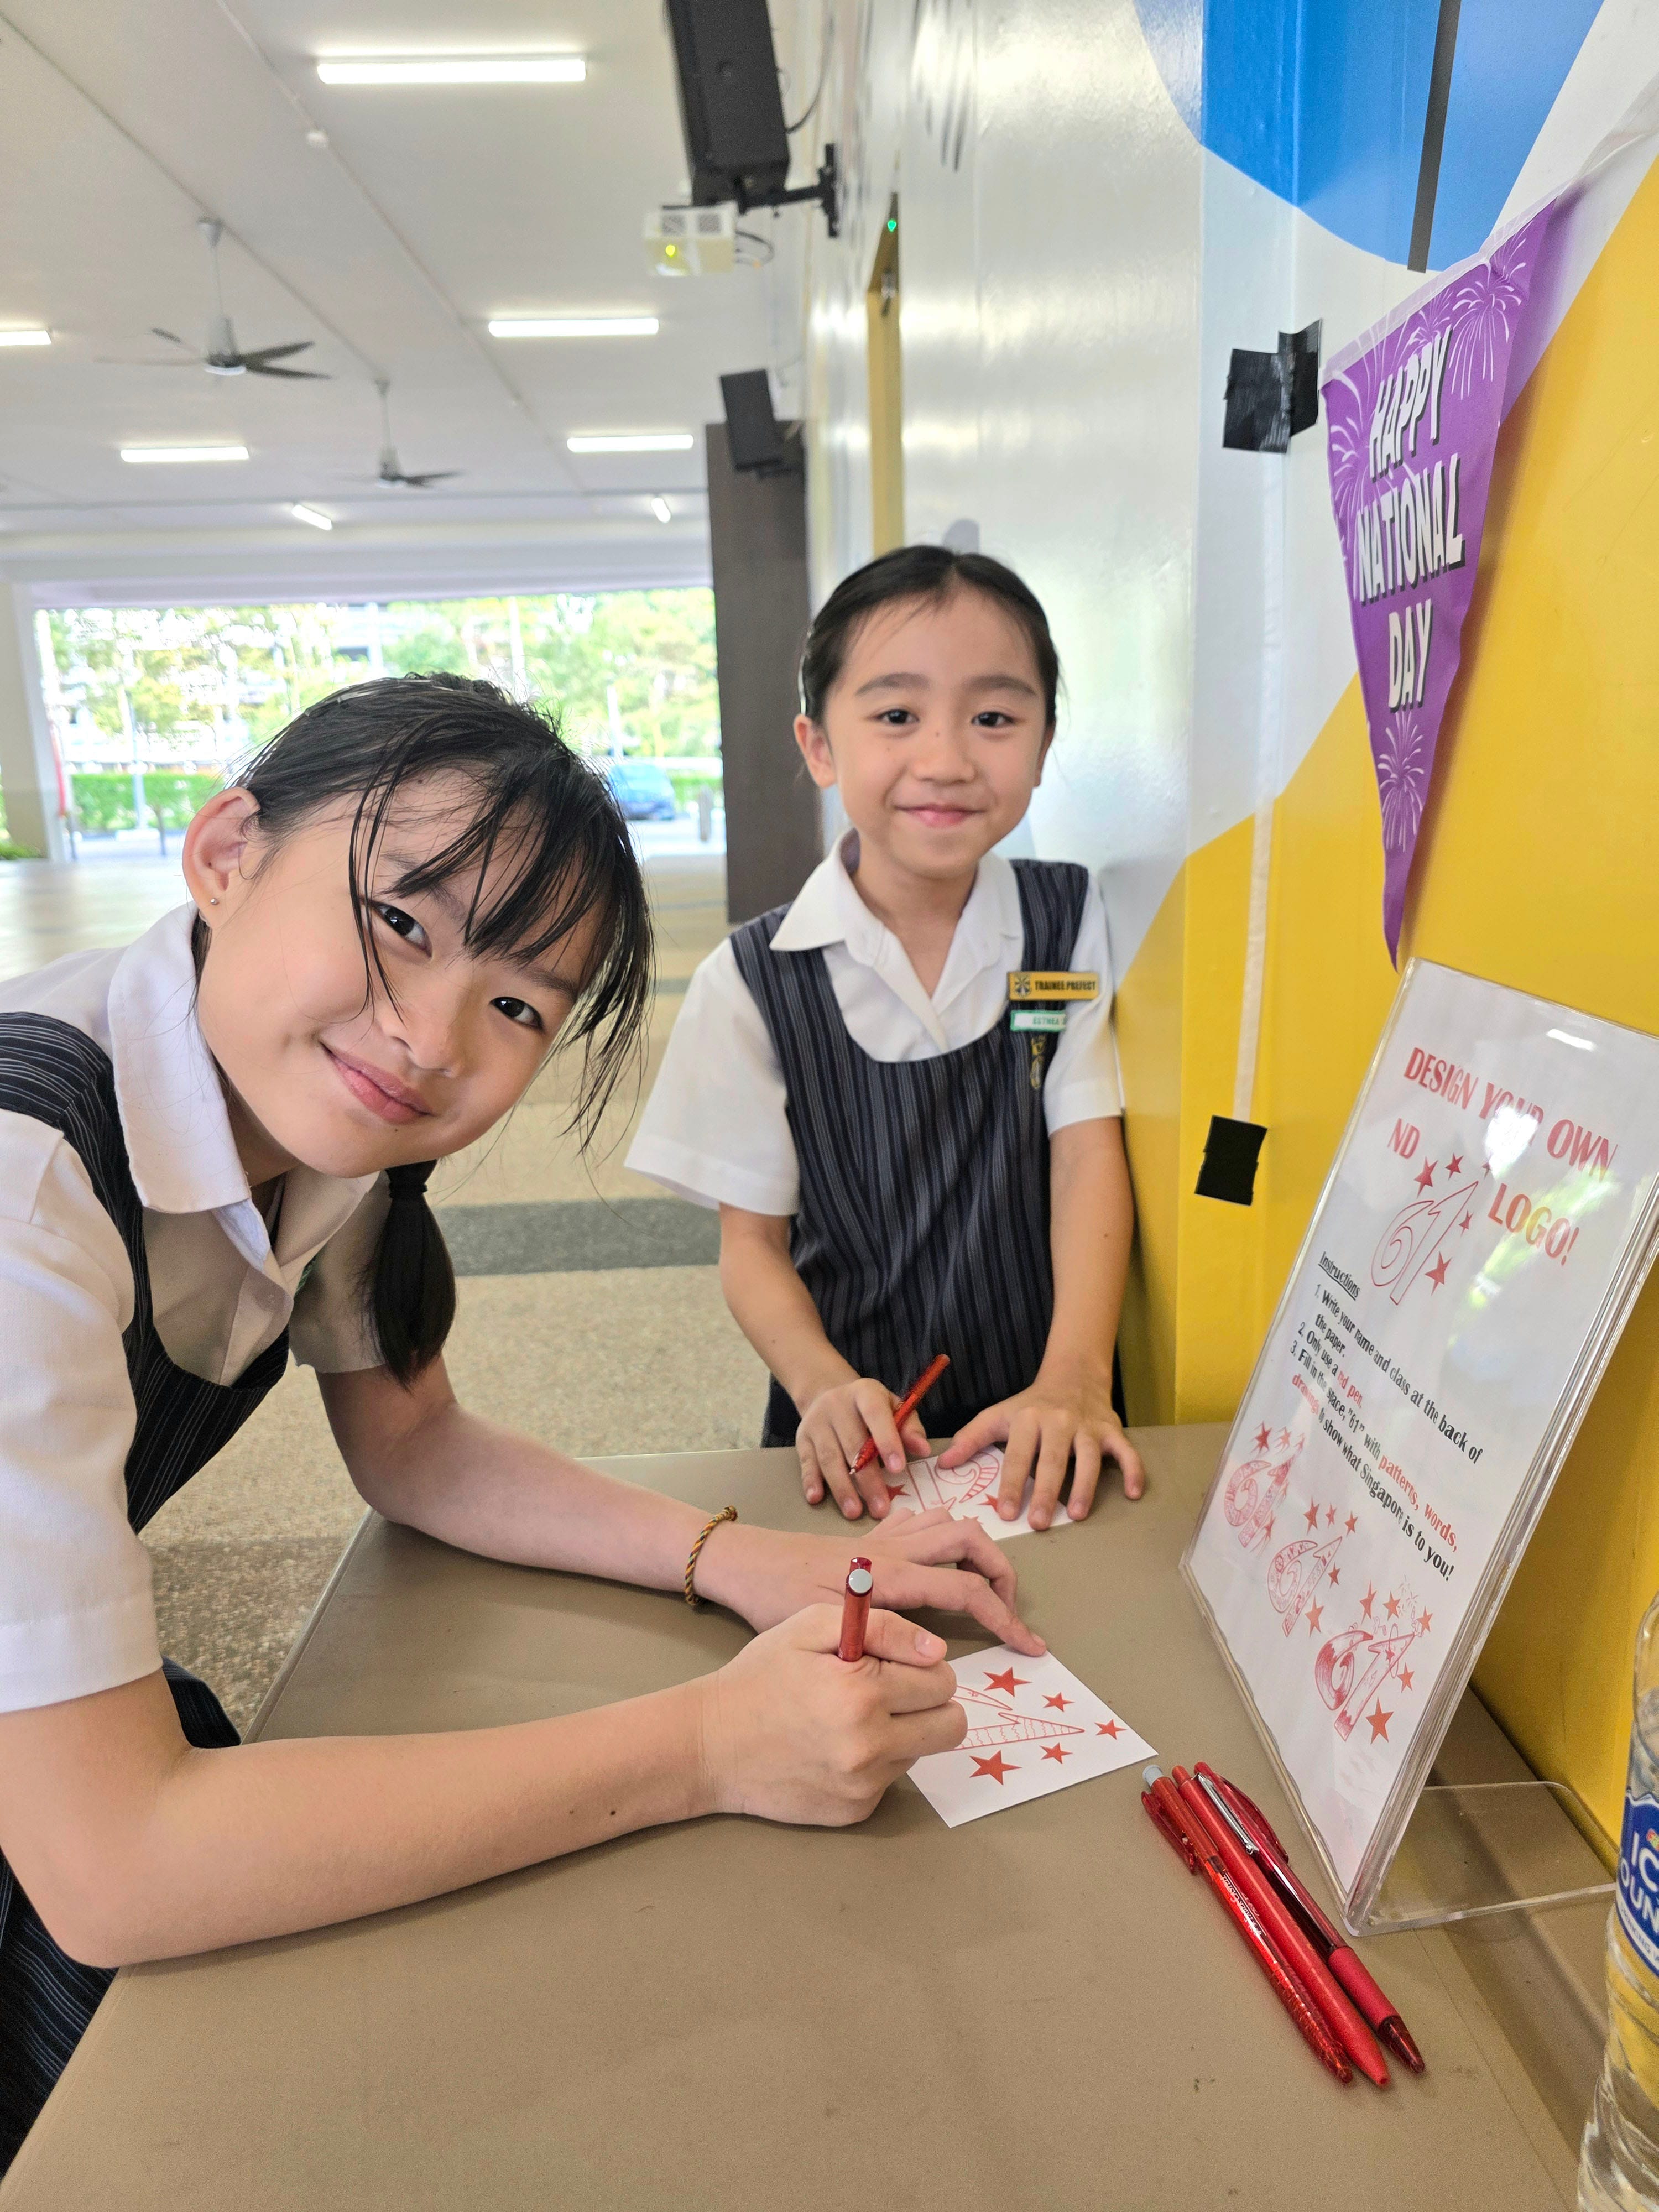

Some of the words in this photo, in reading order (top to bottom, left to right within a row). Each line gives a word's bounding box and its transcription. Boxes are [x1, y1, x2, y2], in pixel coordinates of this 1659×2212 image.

[1369, 325, 1452, 483] HAPPY
[1356, 453, 1465, 607] NATIONAL
[1388, 598, 1433, 713] DAY
[1035, 980, 1065, 991] TRAINEE
[1066, 980, 1096, 991] PREFECT
[1387, 1118, 1420, 1159] ND
[1404, 1047, 1479, 1110] DESIGN
[1547, 1119, 1619, 1183] OWN
[1319, 1251, 1360, 1300] Instructions
[1488, 1183, 1579, 1266] LOGO!
[1298, 1322, 1305, 1337] 2.
[1306, 1331, 1322, 1357] Only
[1321, 1349, 1332, 1370] use
[1332, 1364, 1339, 1376] a
[1337, 1371, 1349, 1390] red
[1315, 1314, 1327, 1333] the
[1324, 1328, 1345, 1357] paper.
[1322, 1290, 1340, 1317] Write
[1338, 1311, 1355, 1333] your
[1354, 1328, 1375, 1355] name
[1373, 1350, 1391, 1373] and
[1389, 1368, 1410, 1395] class
[1410, 1390, 1424, 1407] at
[1423, 1399, 1438, 1424] the
[1438, 1414, 1468, 1452] back
[1468, 1446, 1483, 1464] of
[1290, 1340, 1297, 1357] 3.
[1298, 1348, 1312, 1370] Fill
[1310, 1361, 1317, 1379] in
[1316, 1371, 1327, 1392] the
[1326, 1387, 1345, 1421] space,
[1364, 1433, 1381, 1461] with
[1378, 1455, 1418, 1511] patterns,
[1424, 1503, 1457, 1552] words,
[1292, 1374, 1320, 1416] drawings
[1323, 1419, 1343, 1447] show
[1342, 1442, 1362, 1472] what
[1360, 1463, 1404, 1524] Singapore
[1402, 1515, 1415, 1537] is
[1415, 1530, 1425, 1551] to
[1424, 1546, 1454, 1581] you!
